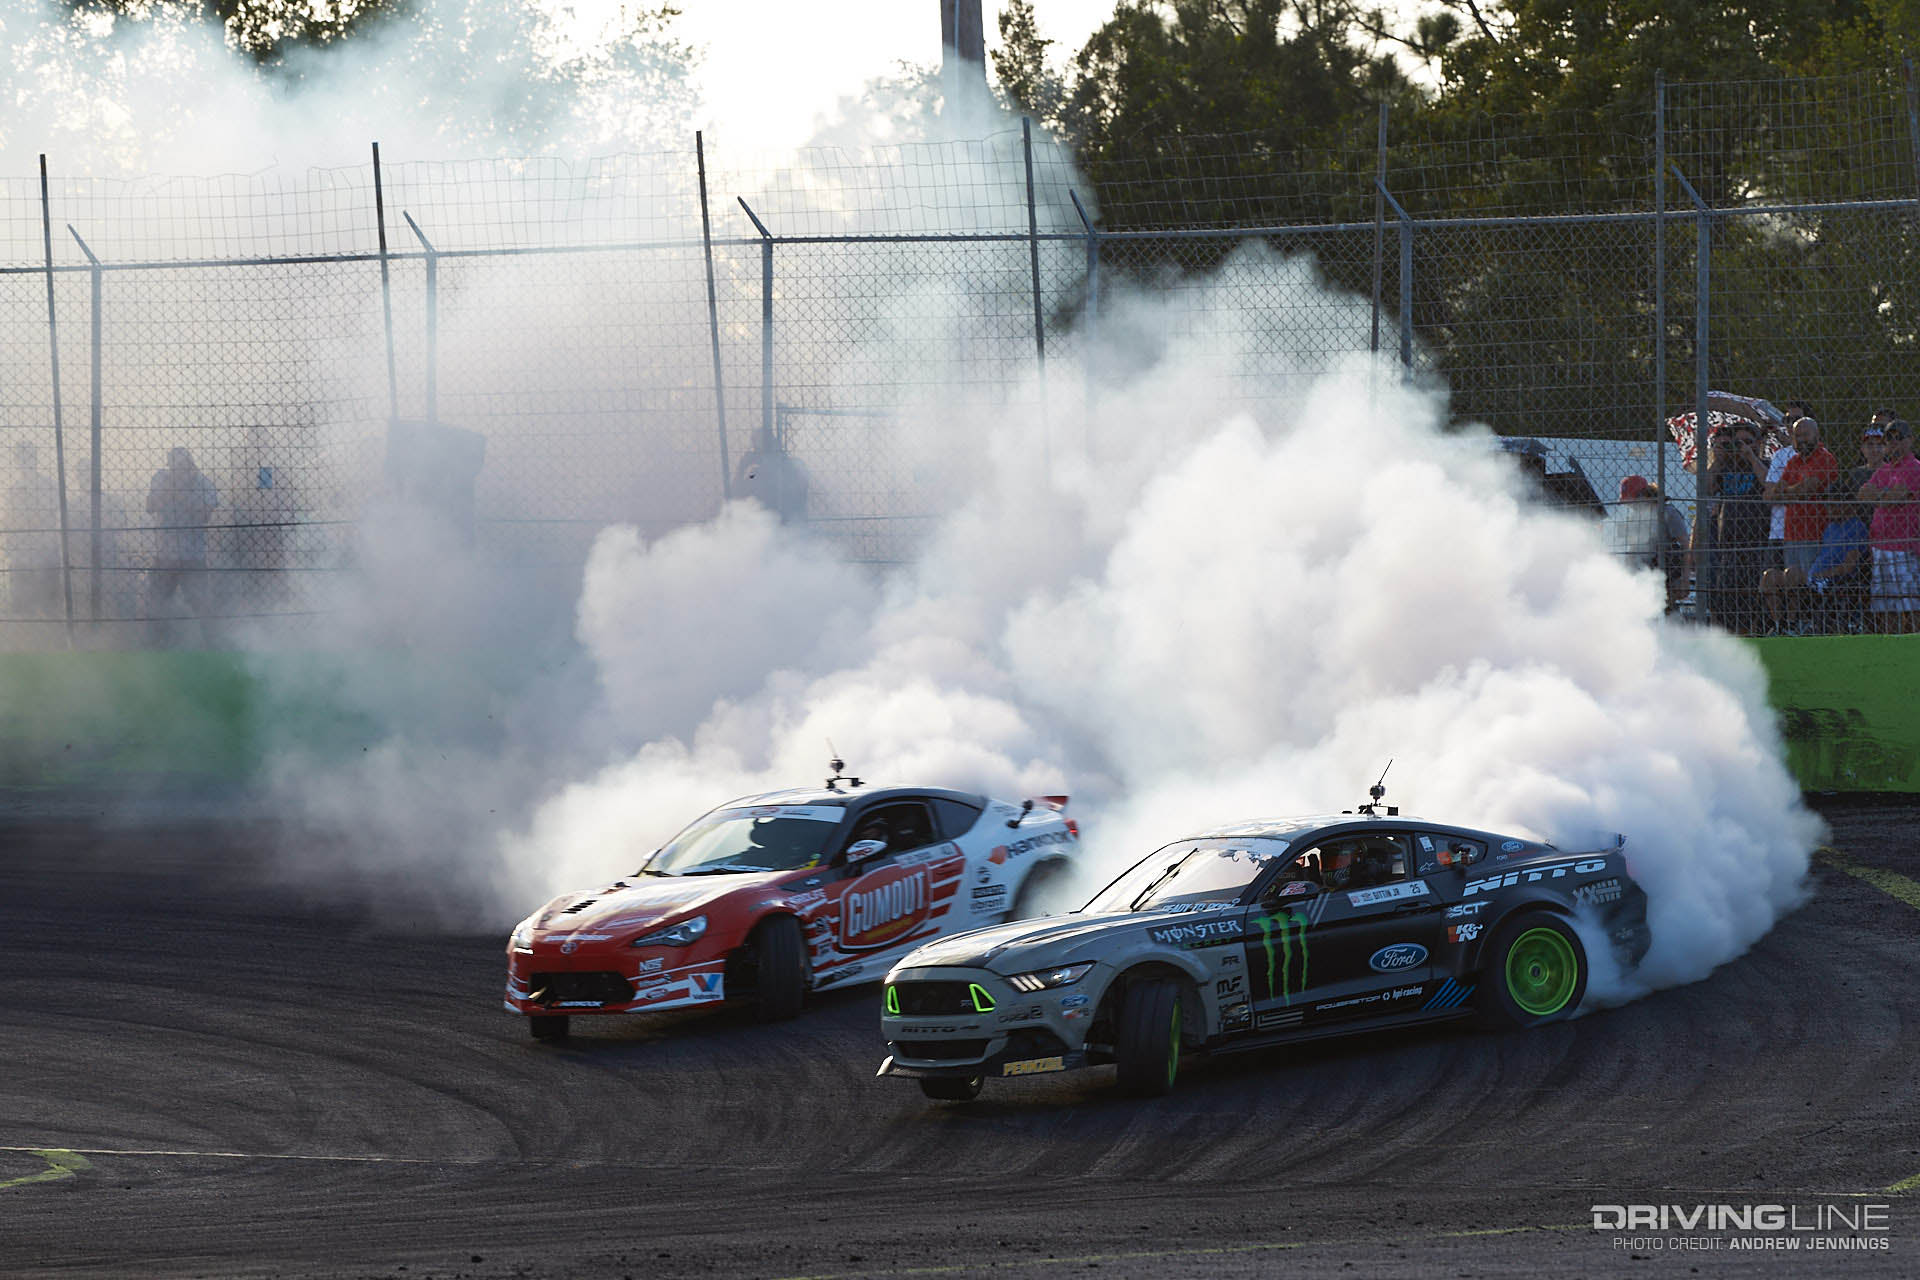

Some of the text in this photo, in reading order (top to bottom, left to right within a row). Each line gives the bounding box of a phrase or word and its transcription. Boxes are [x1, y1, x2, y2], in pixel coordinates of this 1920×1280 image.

[1463, 859, 1606, 897] NITTO
[1372, 888, 1392, 900] GITTIN
[1409, 883, 1421, 894] 25
[848, 872, 925, 937] GUMOUT
[1451, 902, 1491, 918] SCT
[1381, 946, 1416, 968] Ford
[1003, 1057, 1065, 1075] PENNZOIL
